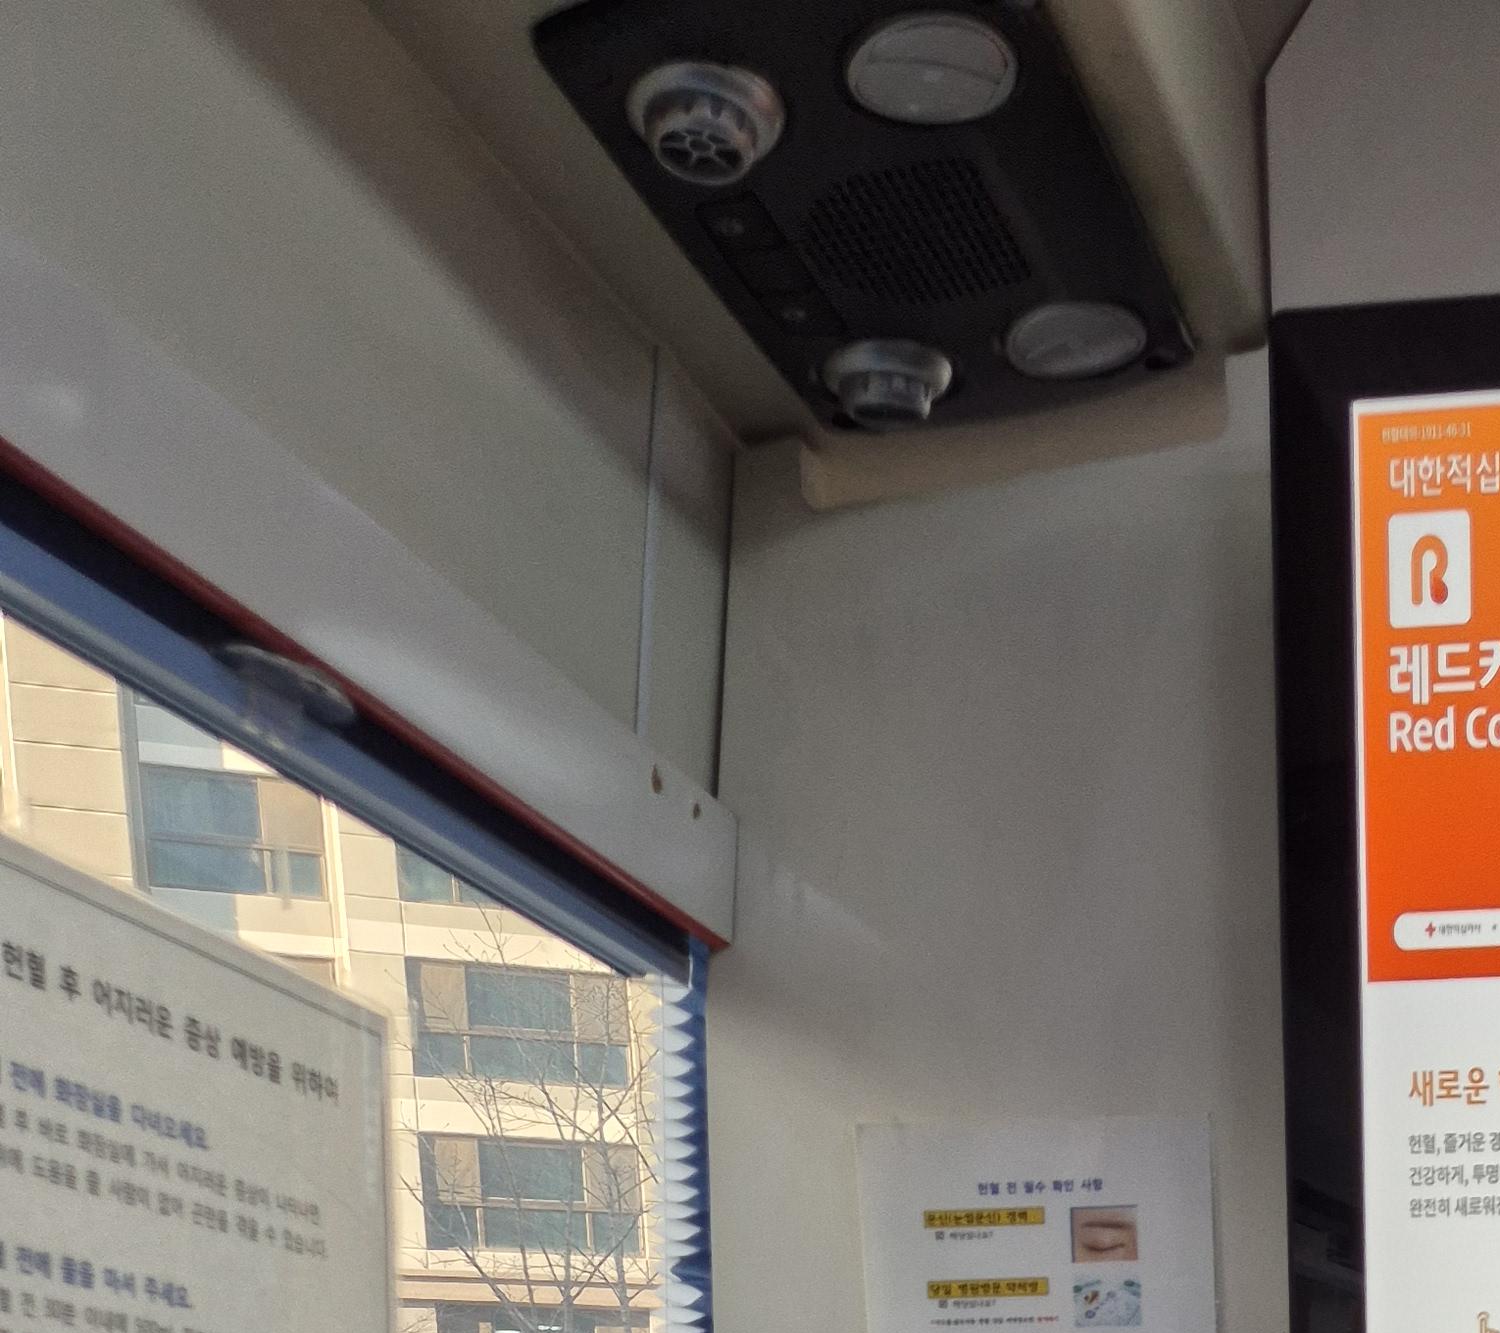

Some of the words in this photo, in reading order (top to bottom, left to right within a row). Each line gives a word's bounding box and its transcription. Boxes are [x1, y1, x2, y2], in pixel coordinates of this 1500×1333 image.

[1389, 704, 1455, 752] Red
[2, 940, 46, 991] 헌혈
[59, 965, 82, 1002] 후
[92, 979, 173, 1041] 어지러운
[183, 1016, 222, 1060] 증상
[230, 1036, 282, 1085] 예방을
[290, 1061, 340, 1107] 위하여
[1408, 1068, 1490, 1107] 새로운
[1408, 1133, 1441, 1156] 헌혈,
[1443, 1131, 1486, 1154] 즐거운
[1409, 1164, 1469, 1187] 건강하게,
[1409, 1197, 1451, 1219] 완전히
